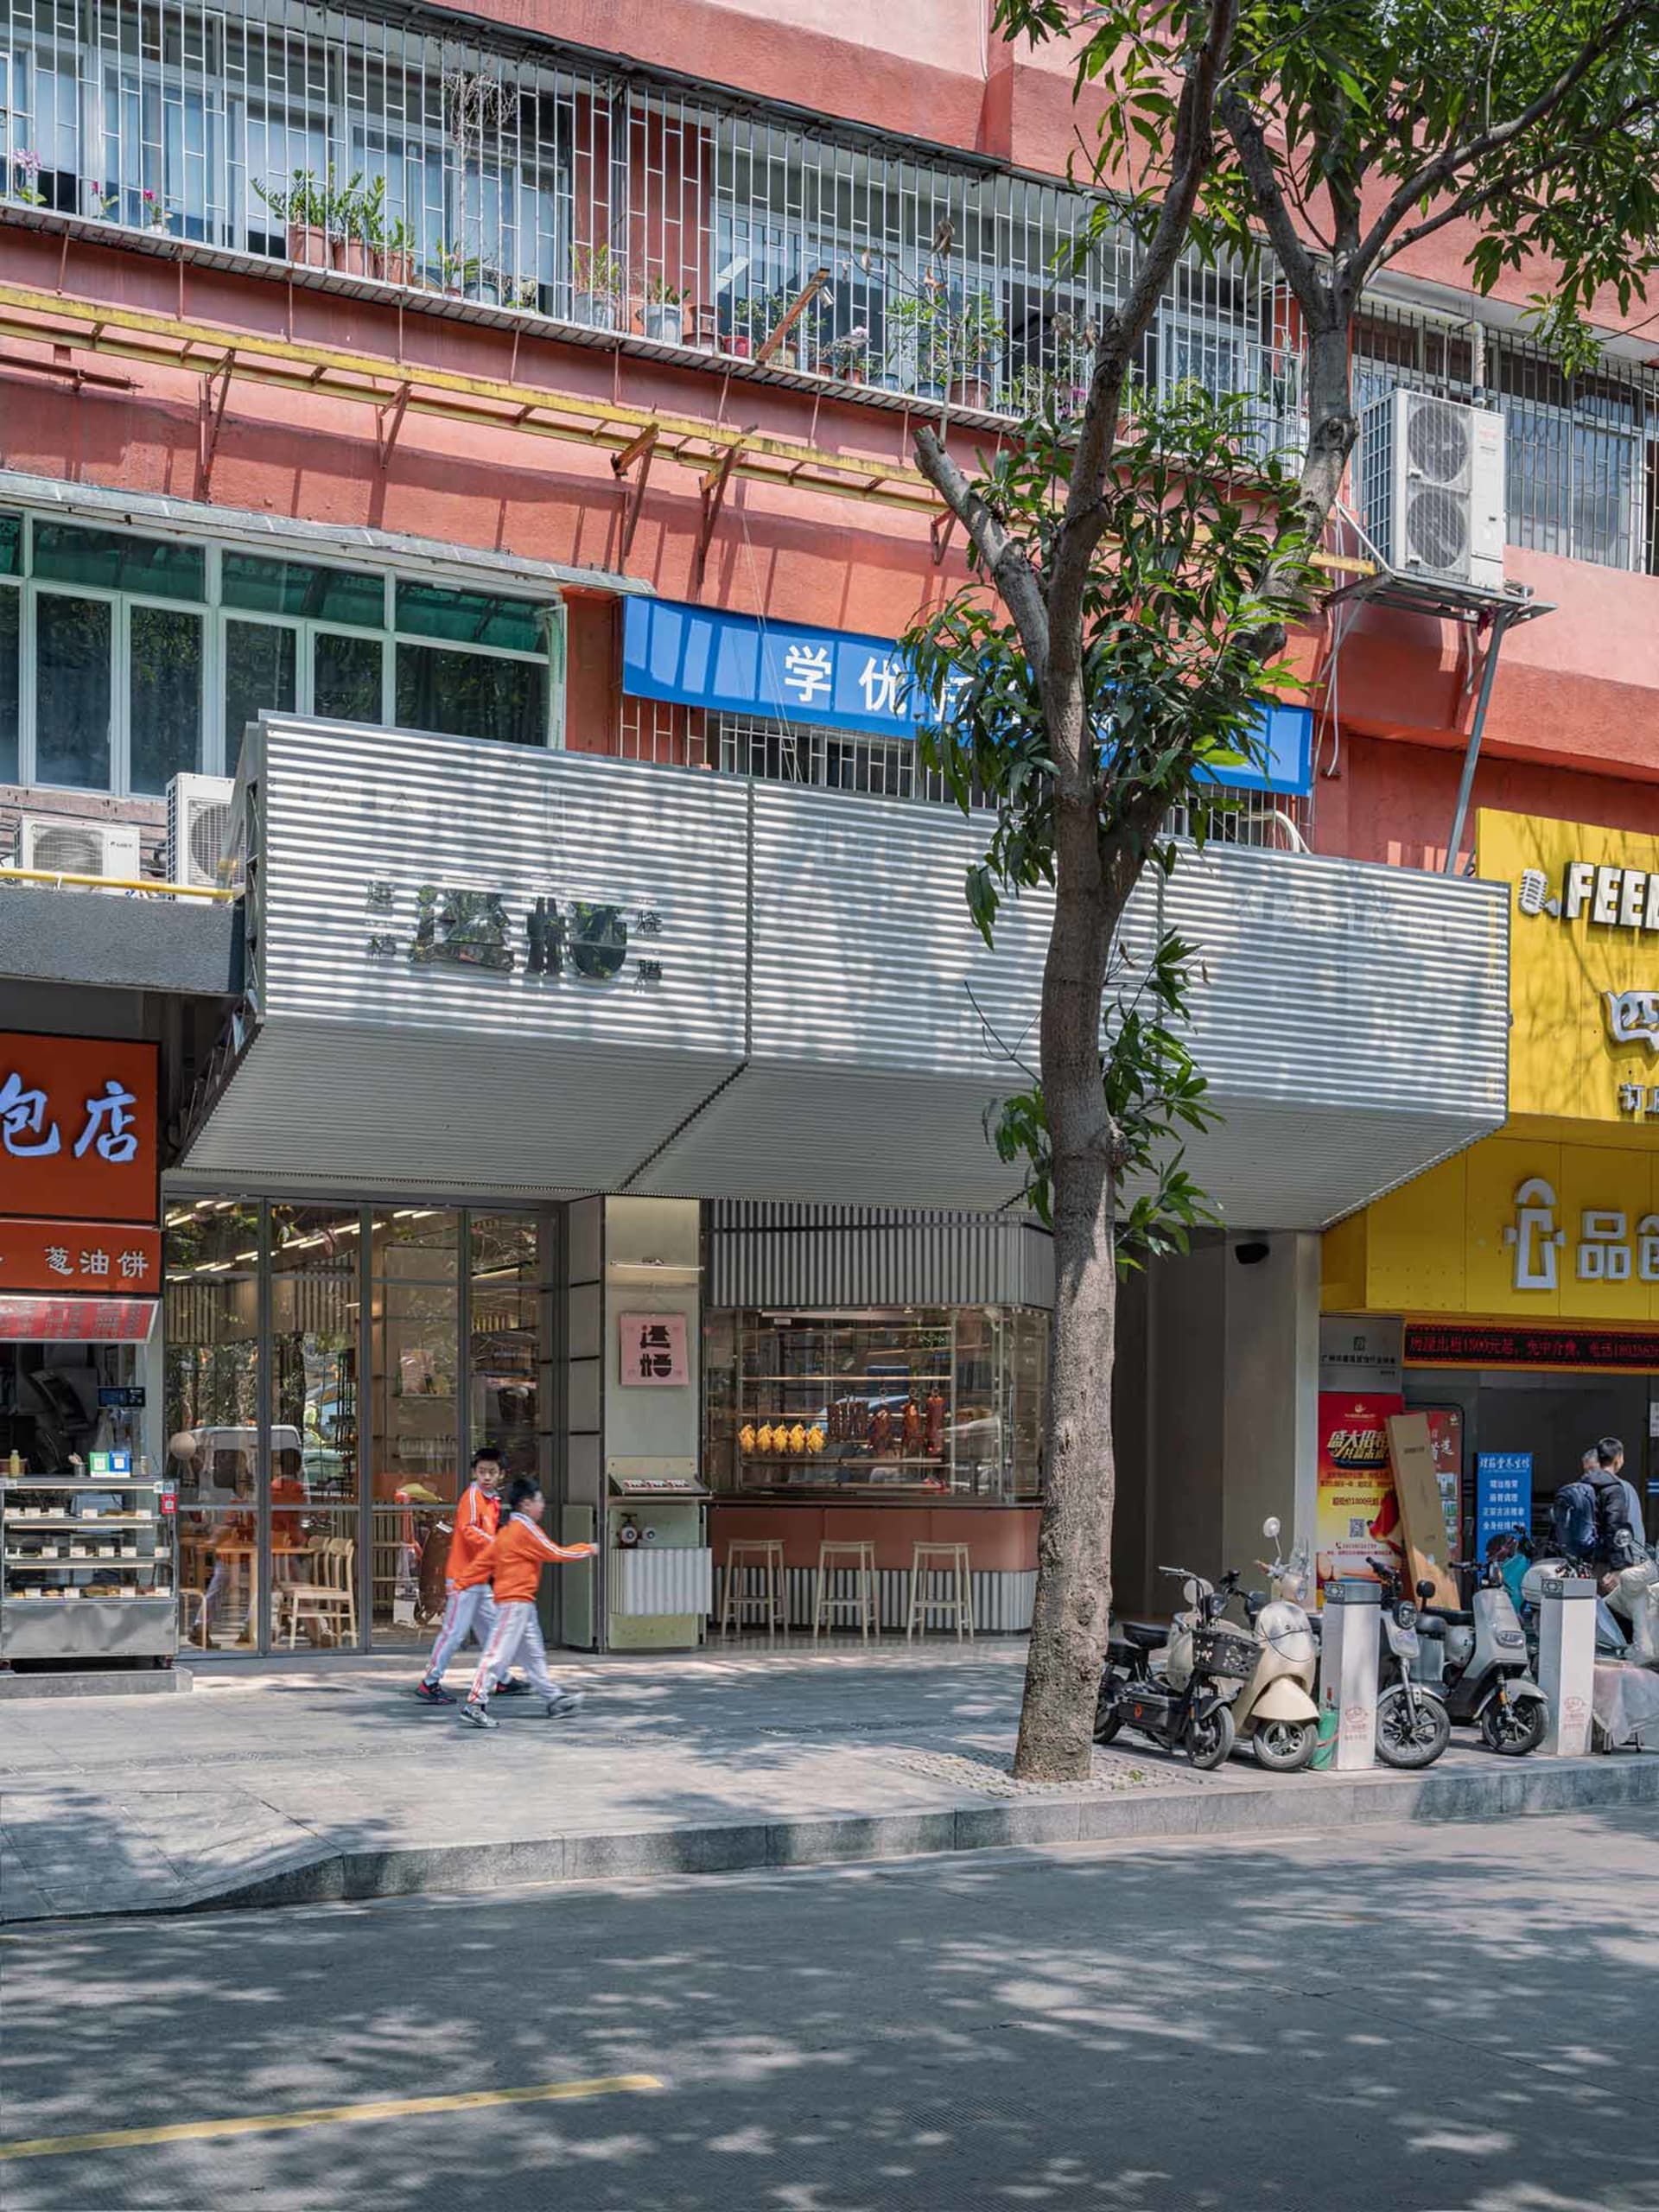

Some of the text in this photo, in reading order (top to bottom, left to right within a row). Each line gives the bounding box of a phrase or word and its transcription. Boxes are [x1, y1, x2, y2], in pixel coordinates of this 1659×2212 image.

[0, 1071, 139, 1163] 包店
[44, 1246, 149, 1279] 葱油饼
